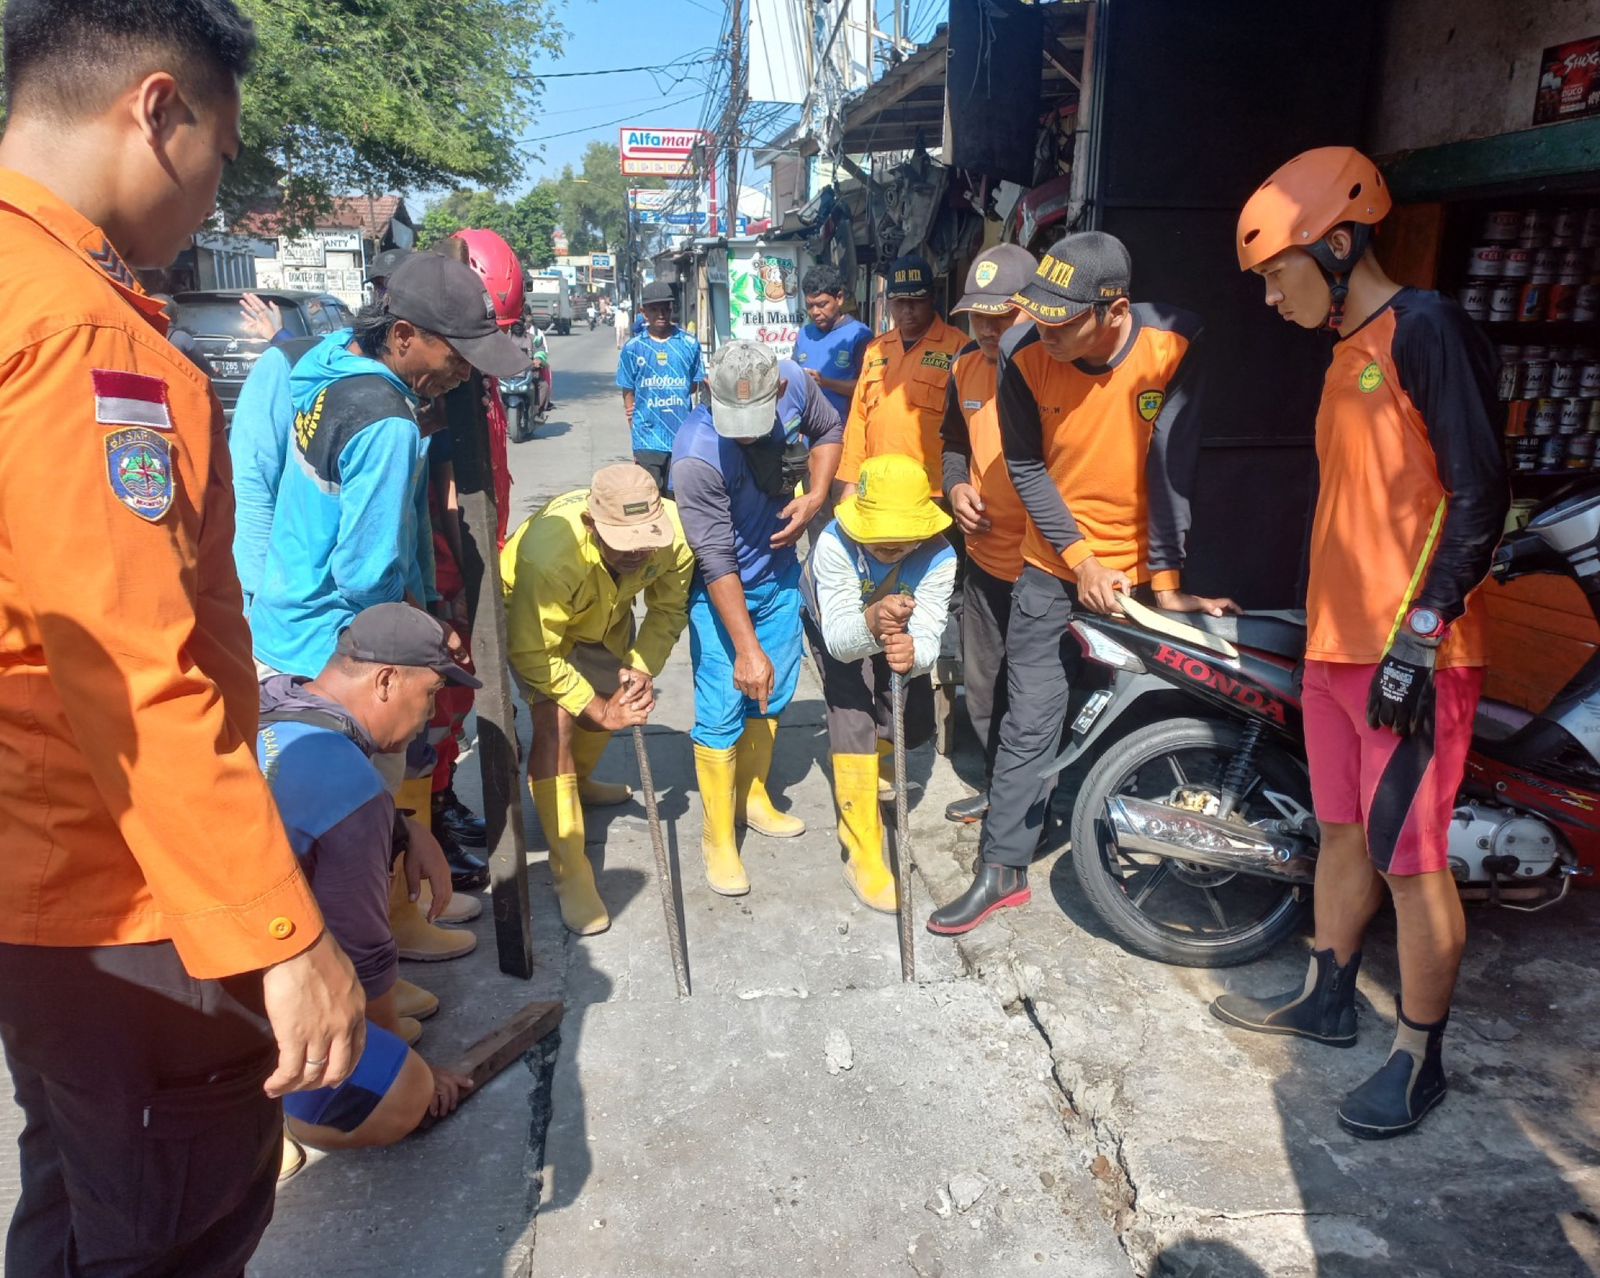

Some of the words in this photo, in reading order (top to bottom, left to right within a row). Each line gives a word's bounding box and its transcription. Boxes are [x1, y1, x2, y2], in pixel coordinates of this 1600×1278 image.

[908, 269, 922, 281] MTA
[743, 312, 765, 325] Teh
[767, 311, 804, 325] Manis
[756, 327, 799, 343] Solo
[640, 374, 686, 389] Indofood
[647, 394, 683, 408] Aladin
[1153, 642, 1287, 725] HONDA
